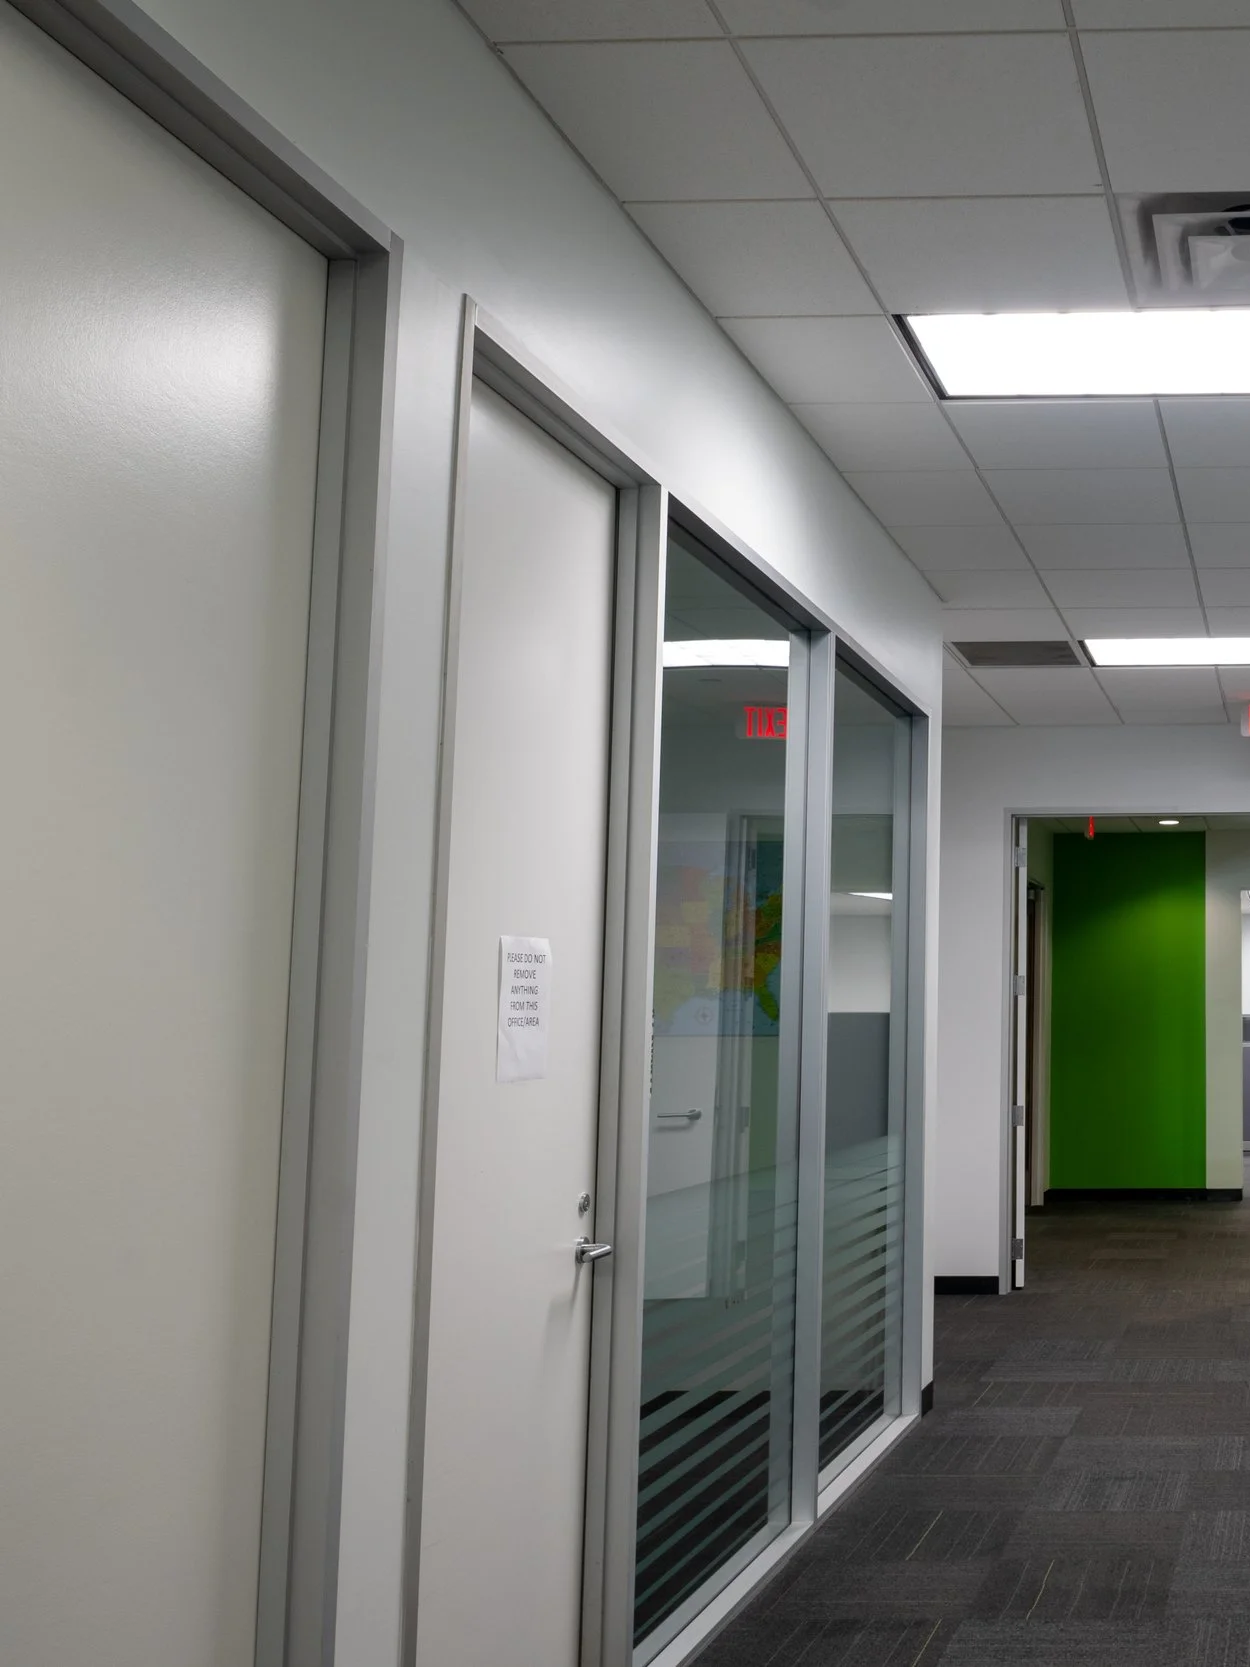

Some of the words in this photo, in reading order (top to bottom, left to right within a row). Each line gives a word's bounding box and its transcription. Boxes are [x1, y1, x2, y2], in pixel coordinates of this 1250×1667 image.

[507, 952, 524, 963] PLEASE
[524, 953, 533, 964] DO
[534, 954, 547, 964] NOT
[514, 969, 537, 980] REMOVE
[511, 985, 540, 995] ANYTHING
[510, 1001, 525, 1011] FROM
[526, 1001, 538, 1011] THIS
[508, 1016, 540, 1028] OFFICE/AREA
